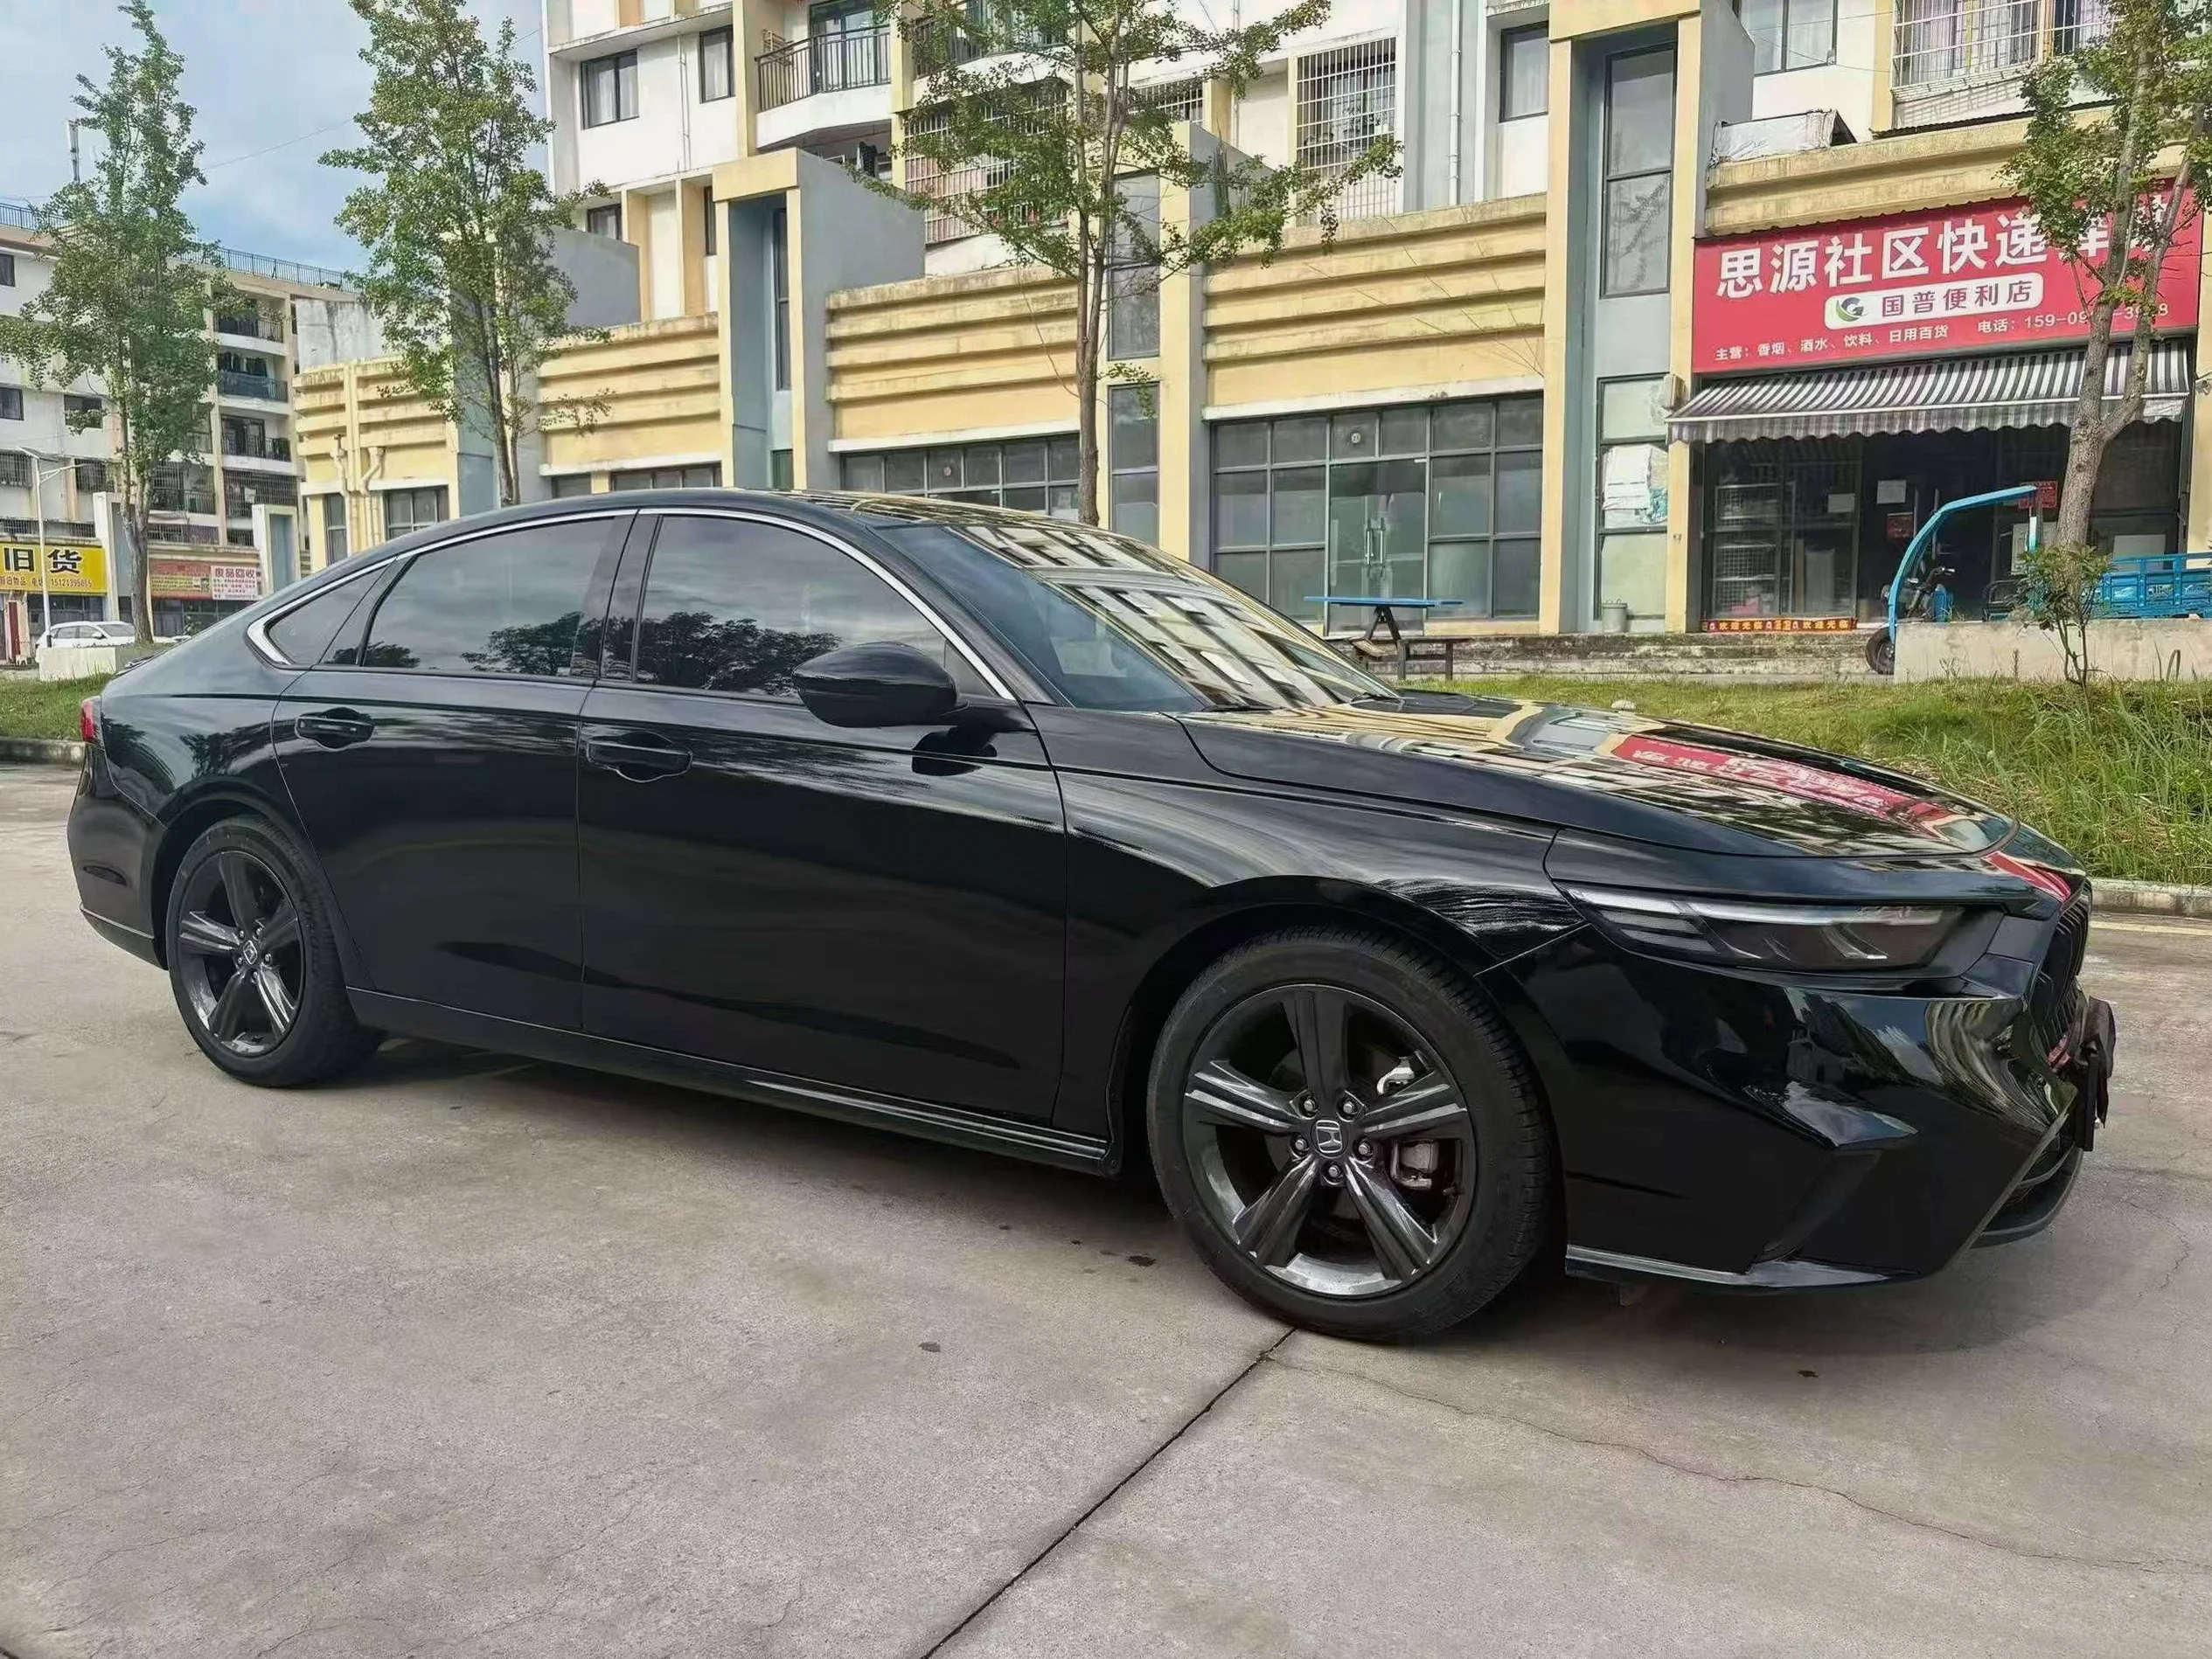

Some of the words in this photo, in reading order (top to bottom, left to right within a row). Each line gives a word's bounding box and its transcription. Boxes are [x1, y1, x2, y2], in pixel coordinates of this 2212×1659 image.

[1882, 281, 2034, 317] 国普便利店
[3, 547, 82, 574] 旧货
